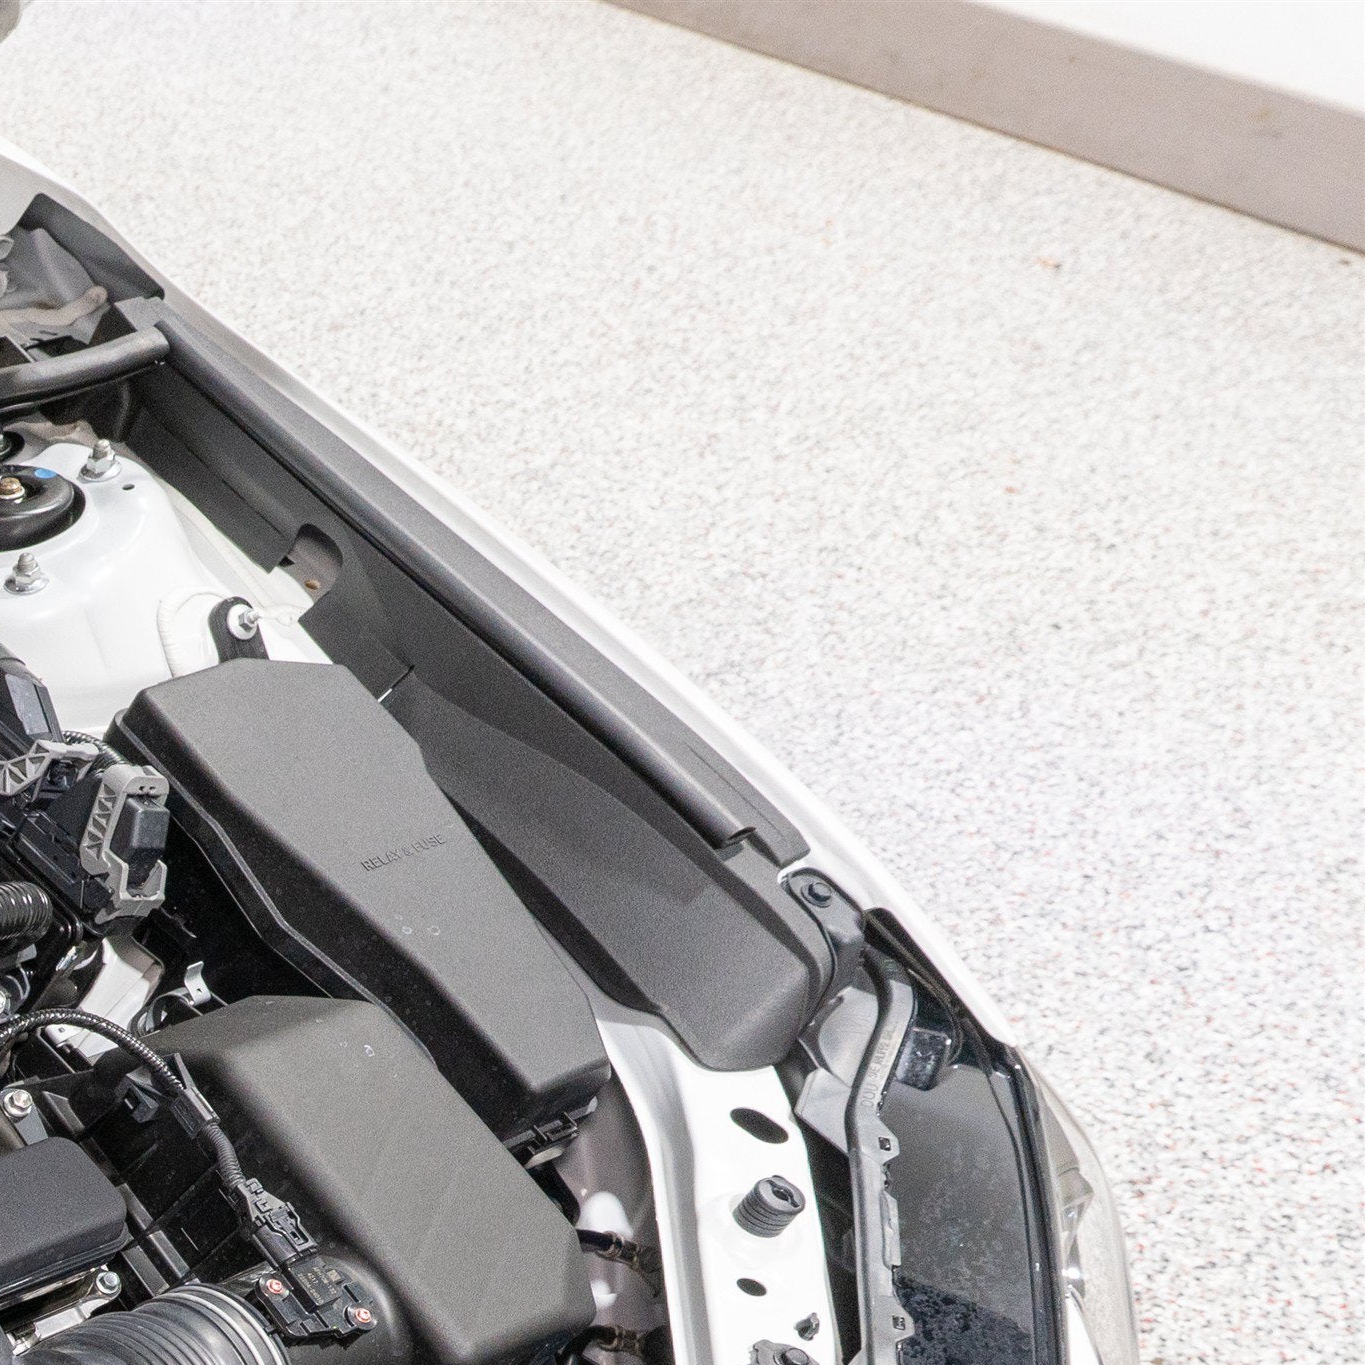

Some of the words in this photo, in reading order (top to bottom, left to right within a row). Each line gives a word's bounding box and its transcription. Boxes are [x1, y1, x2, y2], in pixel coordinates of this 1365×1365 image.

[360, 848, 402, 871] RELAY
[402, 846, 414, 857] &
[412, 833, 447, 854] FUSE
